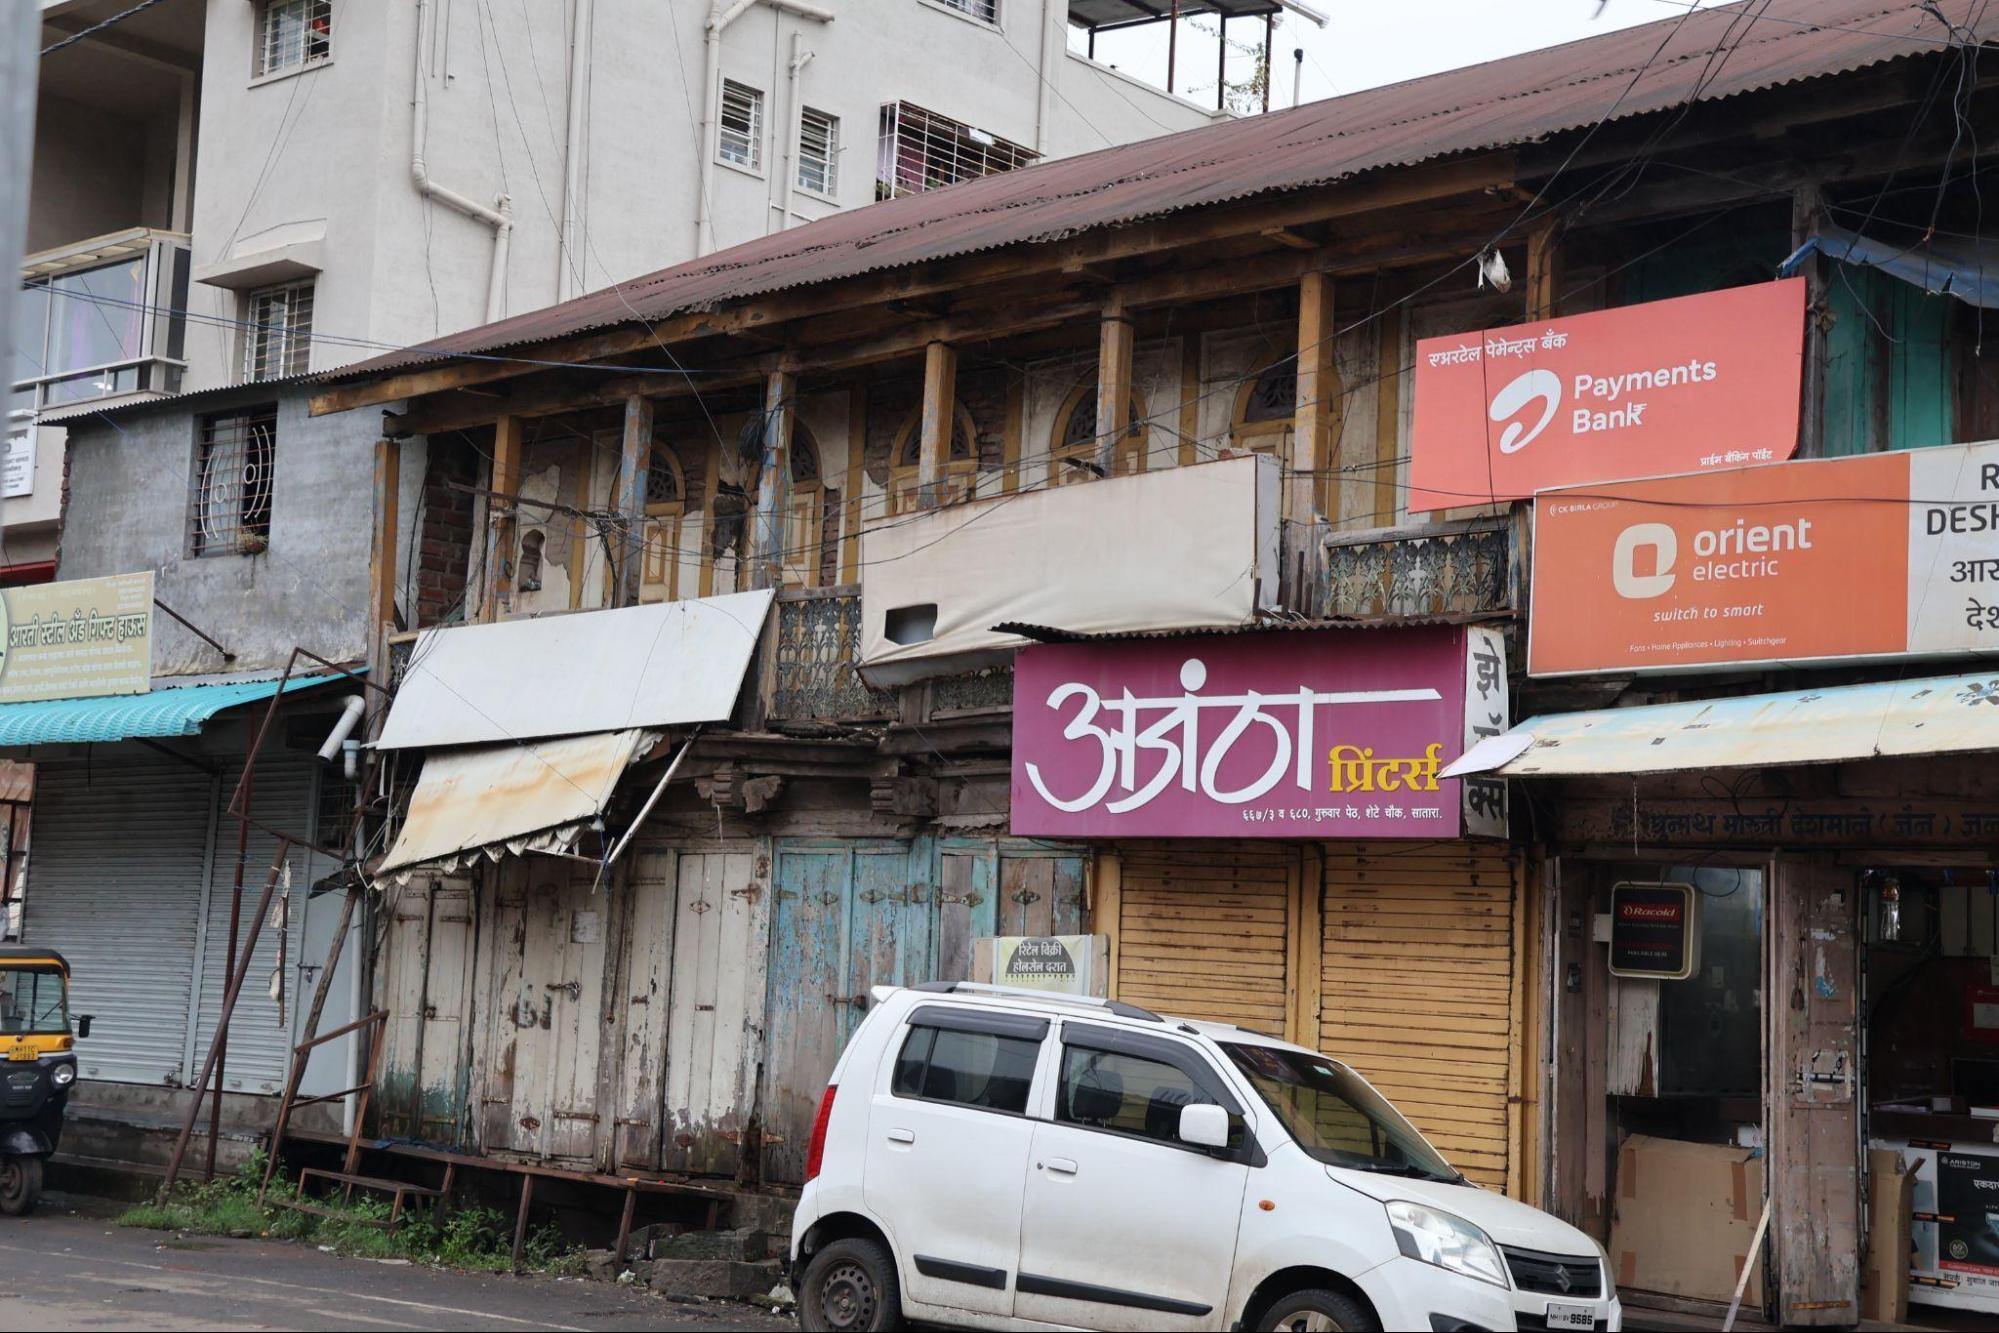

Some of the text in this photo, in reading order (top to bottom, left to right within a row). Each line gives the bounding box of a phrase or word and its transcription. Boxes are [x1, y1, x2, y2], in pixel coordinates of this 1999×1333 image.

[1541, 329, 1568, 349] बँक
[1574, 358, 1717, 401] Payments
[1573, 402, 1647, 434] Bank
[1570, 504, 1591, 512] BIRLA
[1694, 517, 1812, 556] orient
[1693, 555, 1780, 582] electric
[1653, 604, 1765, 622] switch to smart
[9, 615, 38, 648] आरती
[41, 614, 66, 646] स्टील
[88, 608, 115, 642] गिफ्ट
[117, 613, 147, 644] हाऊस
[1651, 642, 1671, 652] Home
[1672, 641, 1709, 651] Appliances
[1714, 639, 1742, 649] Lighting
[1748, 637, 1787, 647] Switchgear
[1329, 743, 1443, 794] प्रिंटर्स
[1634, 907, 1676, 917] Racold
[1018, 942, 1038, 957] रिटेल
[1045, 961, 1067, 973] दरात
[1570, 1313, 1593, 1325] 9585
